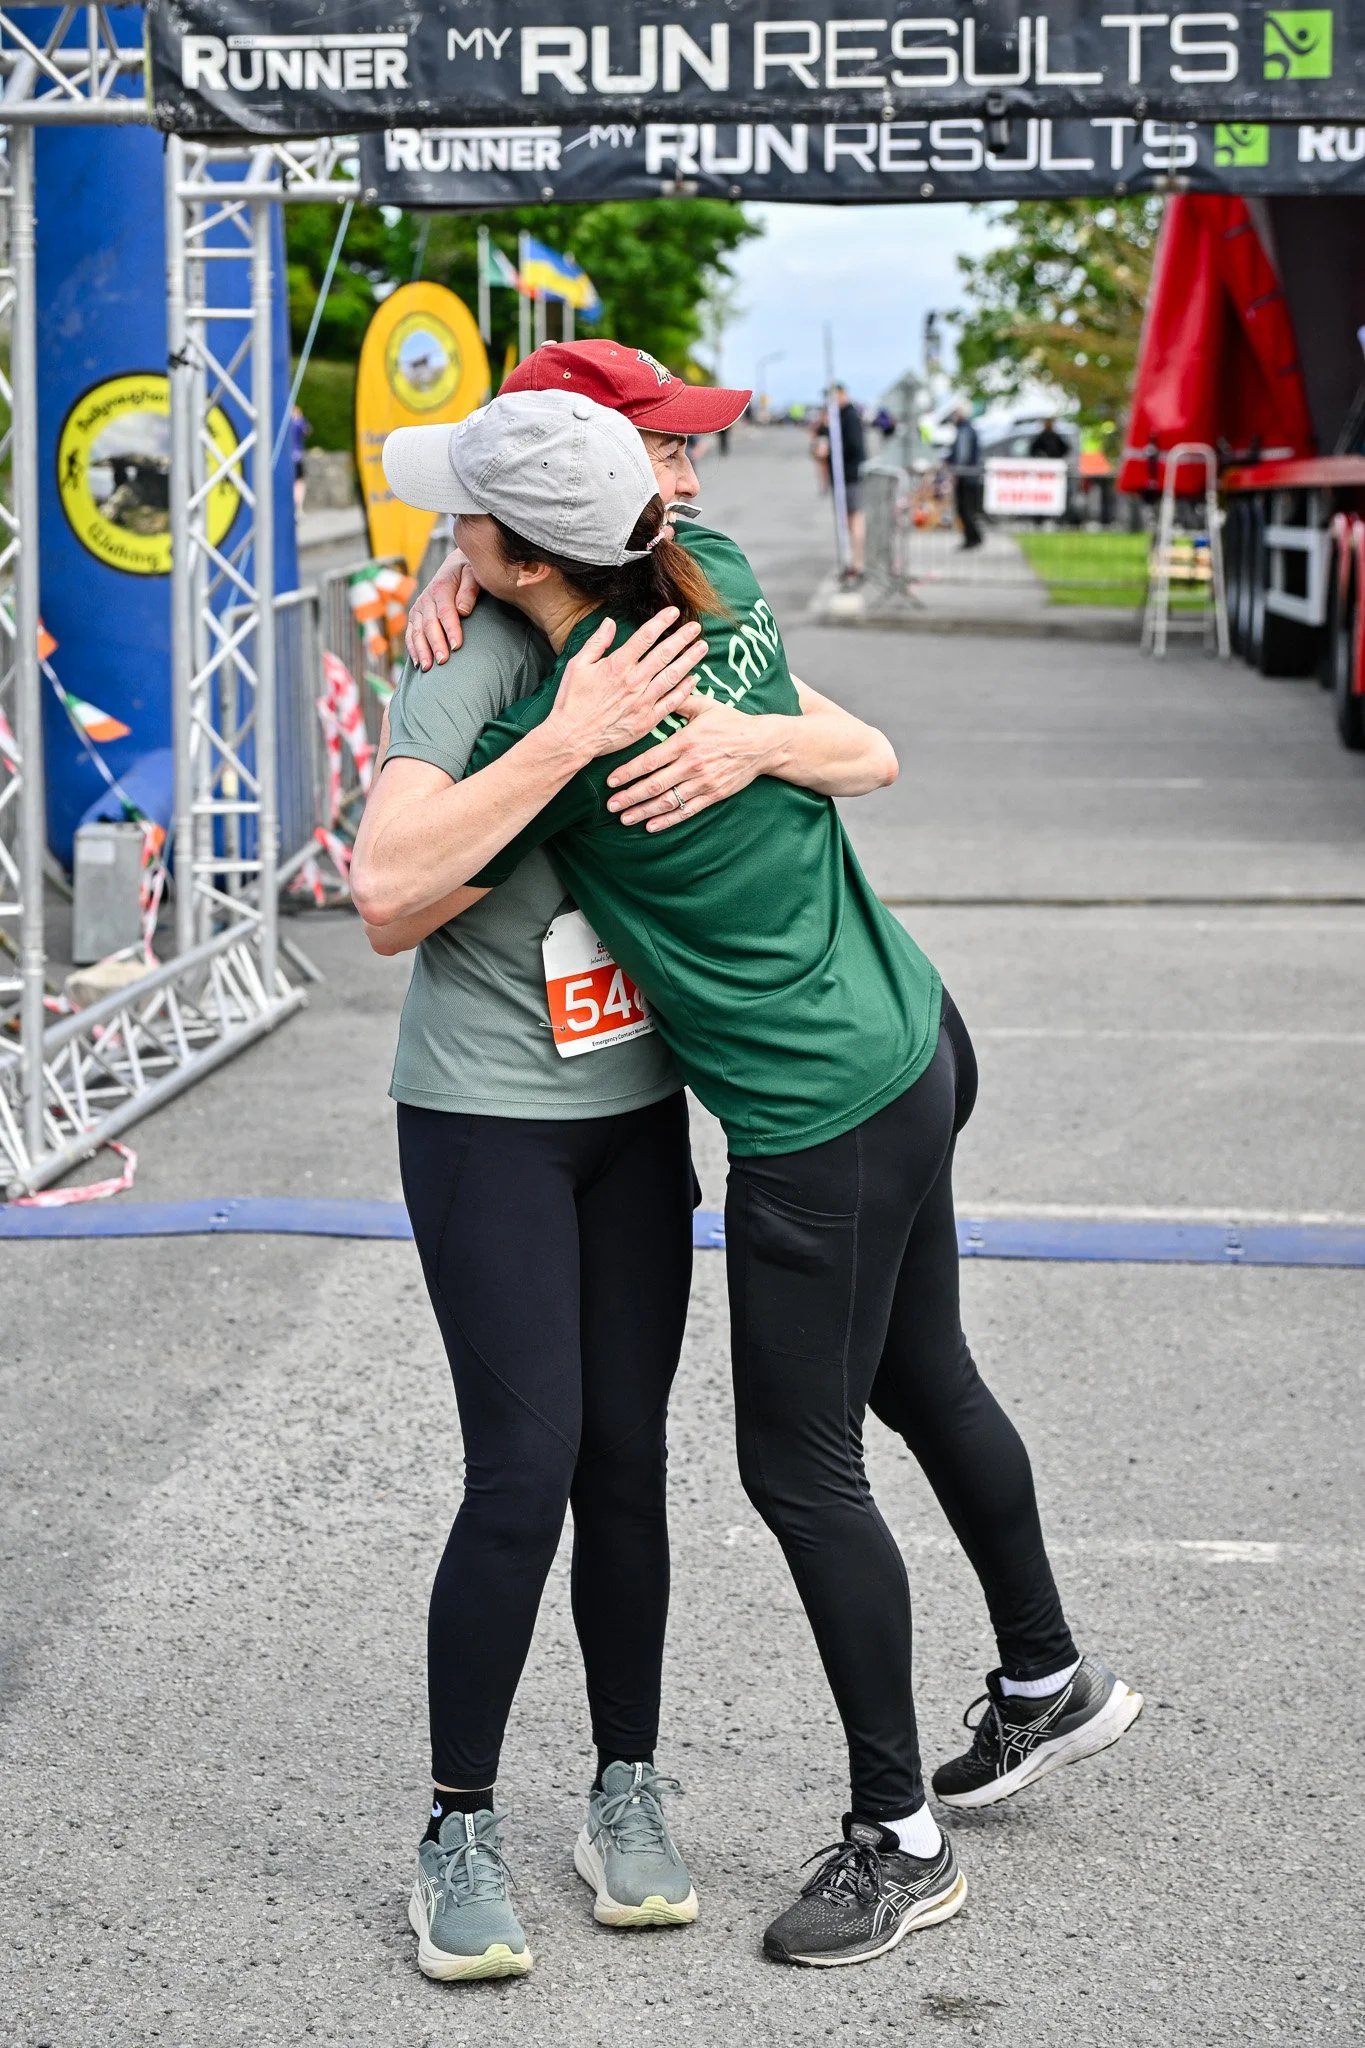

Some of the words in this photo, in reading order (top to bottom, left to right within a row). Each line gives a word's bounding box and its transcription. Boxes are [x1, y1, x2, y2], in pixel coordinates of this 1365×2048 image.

[182, 34, 409, 91] RUNNER
[447, 27, 512, 61] MY
[521, 22, 730, 95] RUN
[753, 12, 1240, 90] RESULTS
[384, 126, 562, 173] RUNNER
[589, 124, 636, 149] MY
[645, 123, 808, 175] RUN
[824, 117, 1198, 174] RESULTS
[592, 1035, 618, 1047] Emergency
[618, 1030, 635, 1040] Contact
[634, 1024, 650, 1035] Number
